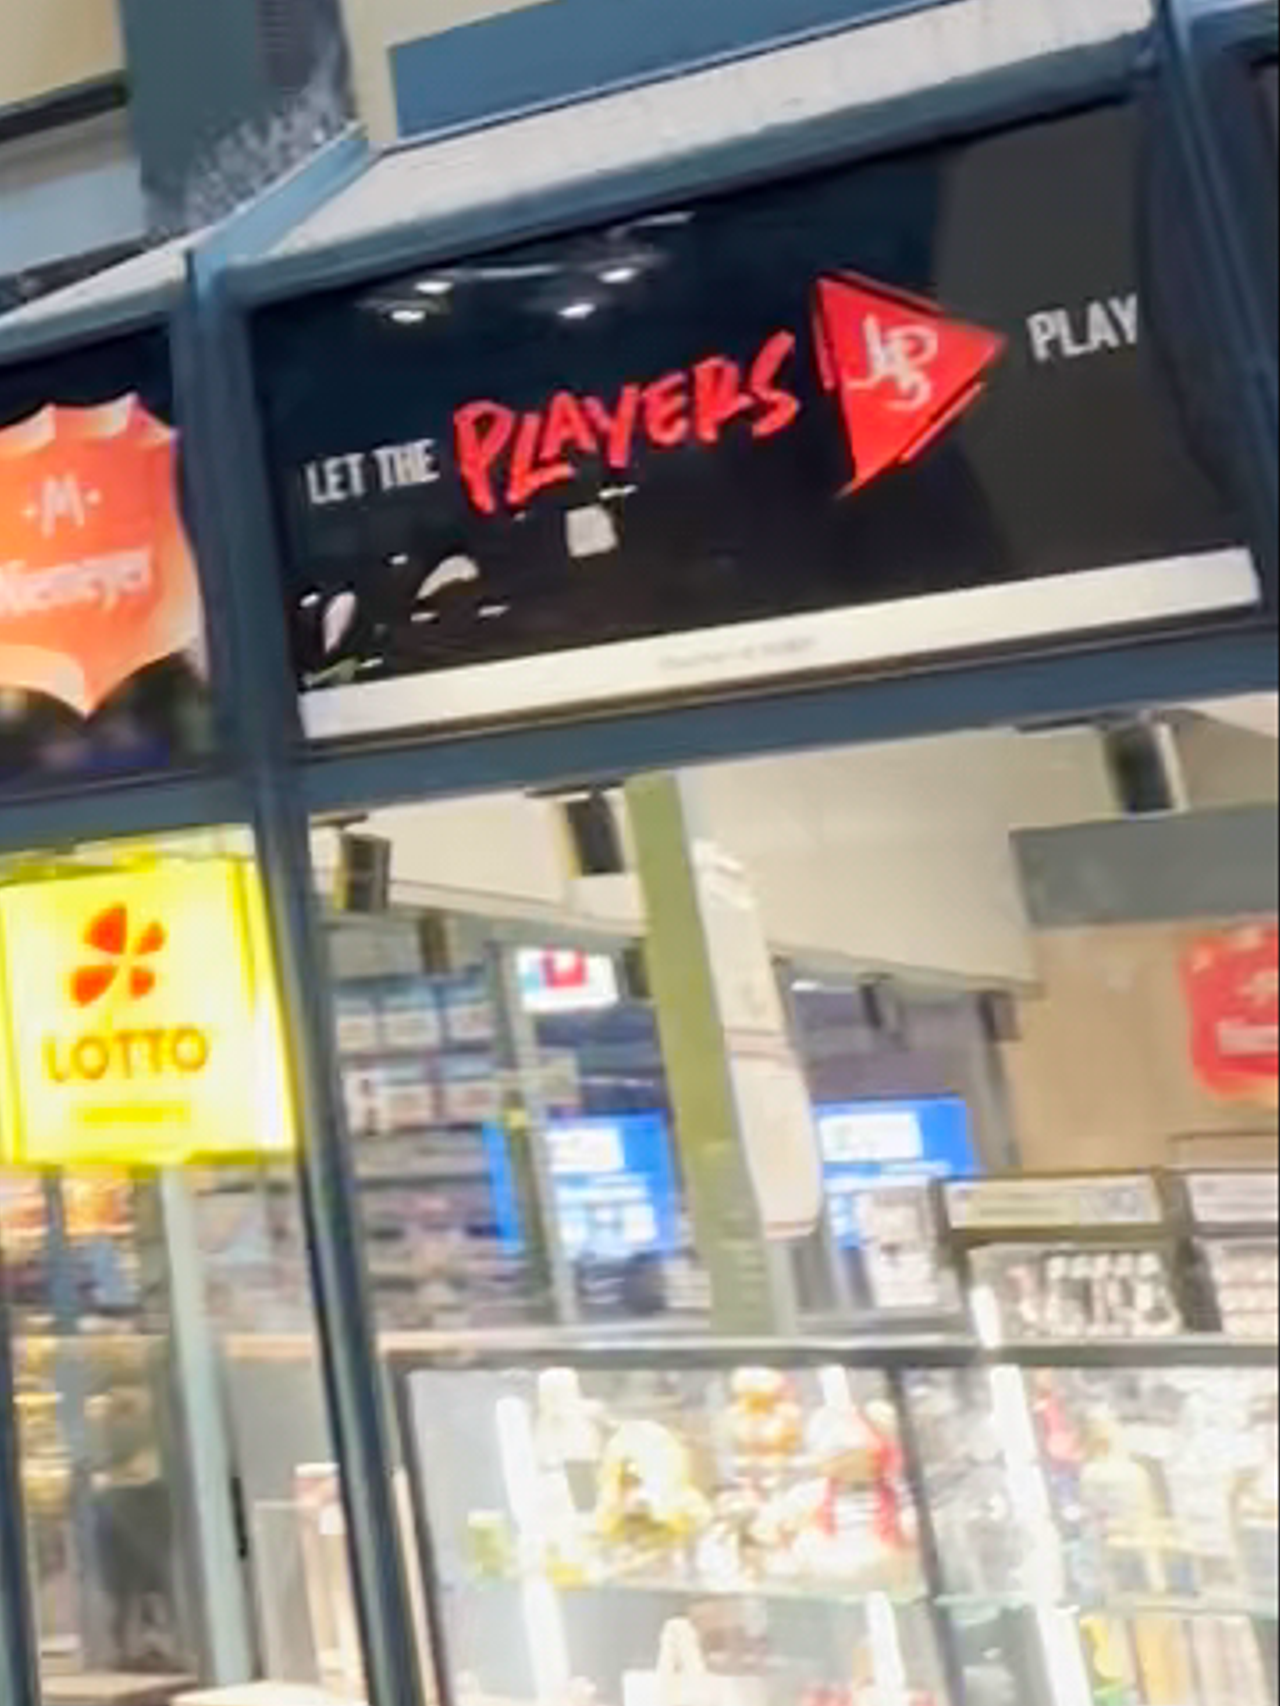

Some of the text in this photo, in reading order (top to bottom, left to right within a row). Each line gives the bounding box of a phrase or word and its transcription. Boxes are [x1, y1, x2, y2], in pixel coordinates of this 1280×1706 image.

[307, 292, 1139, 514] LET THE PLAYERS PLAY
[42, 1026, 208, 1084] LOTTO
